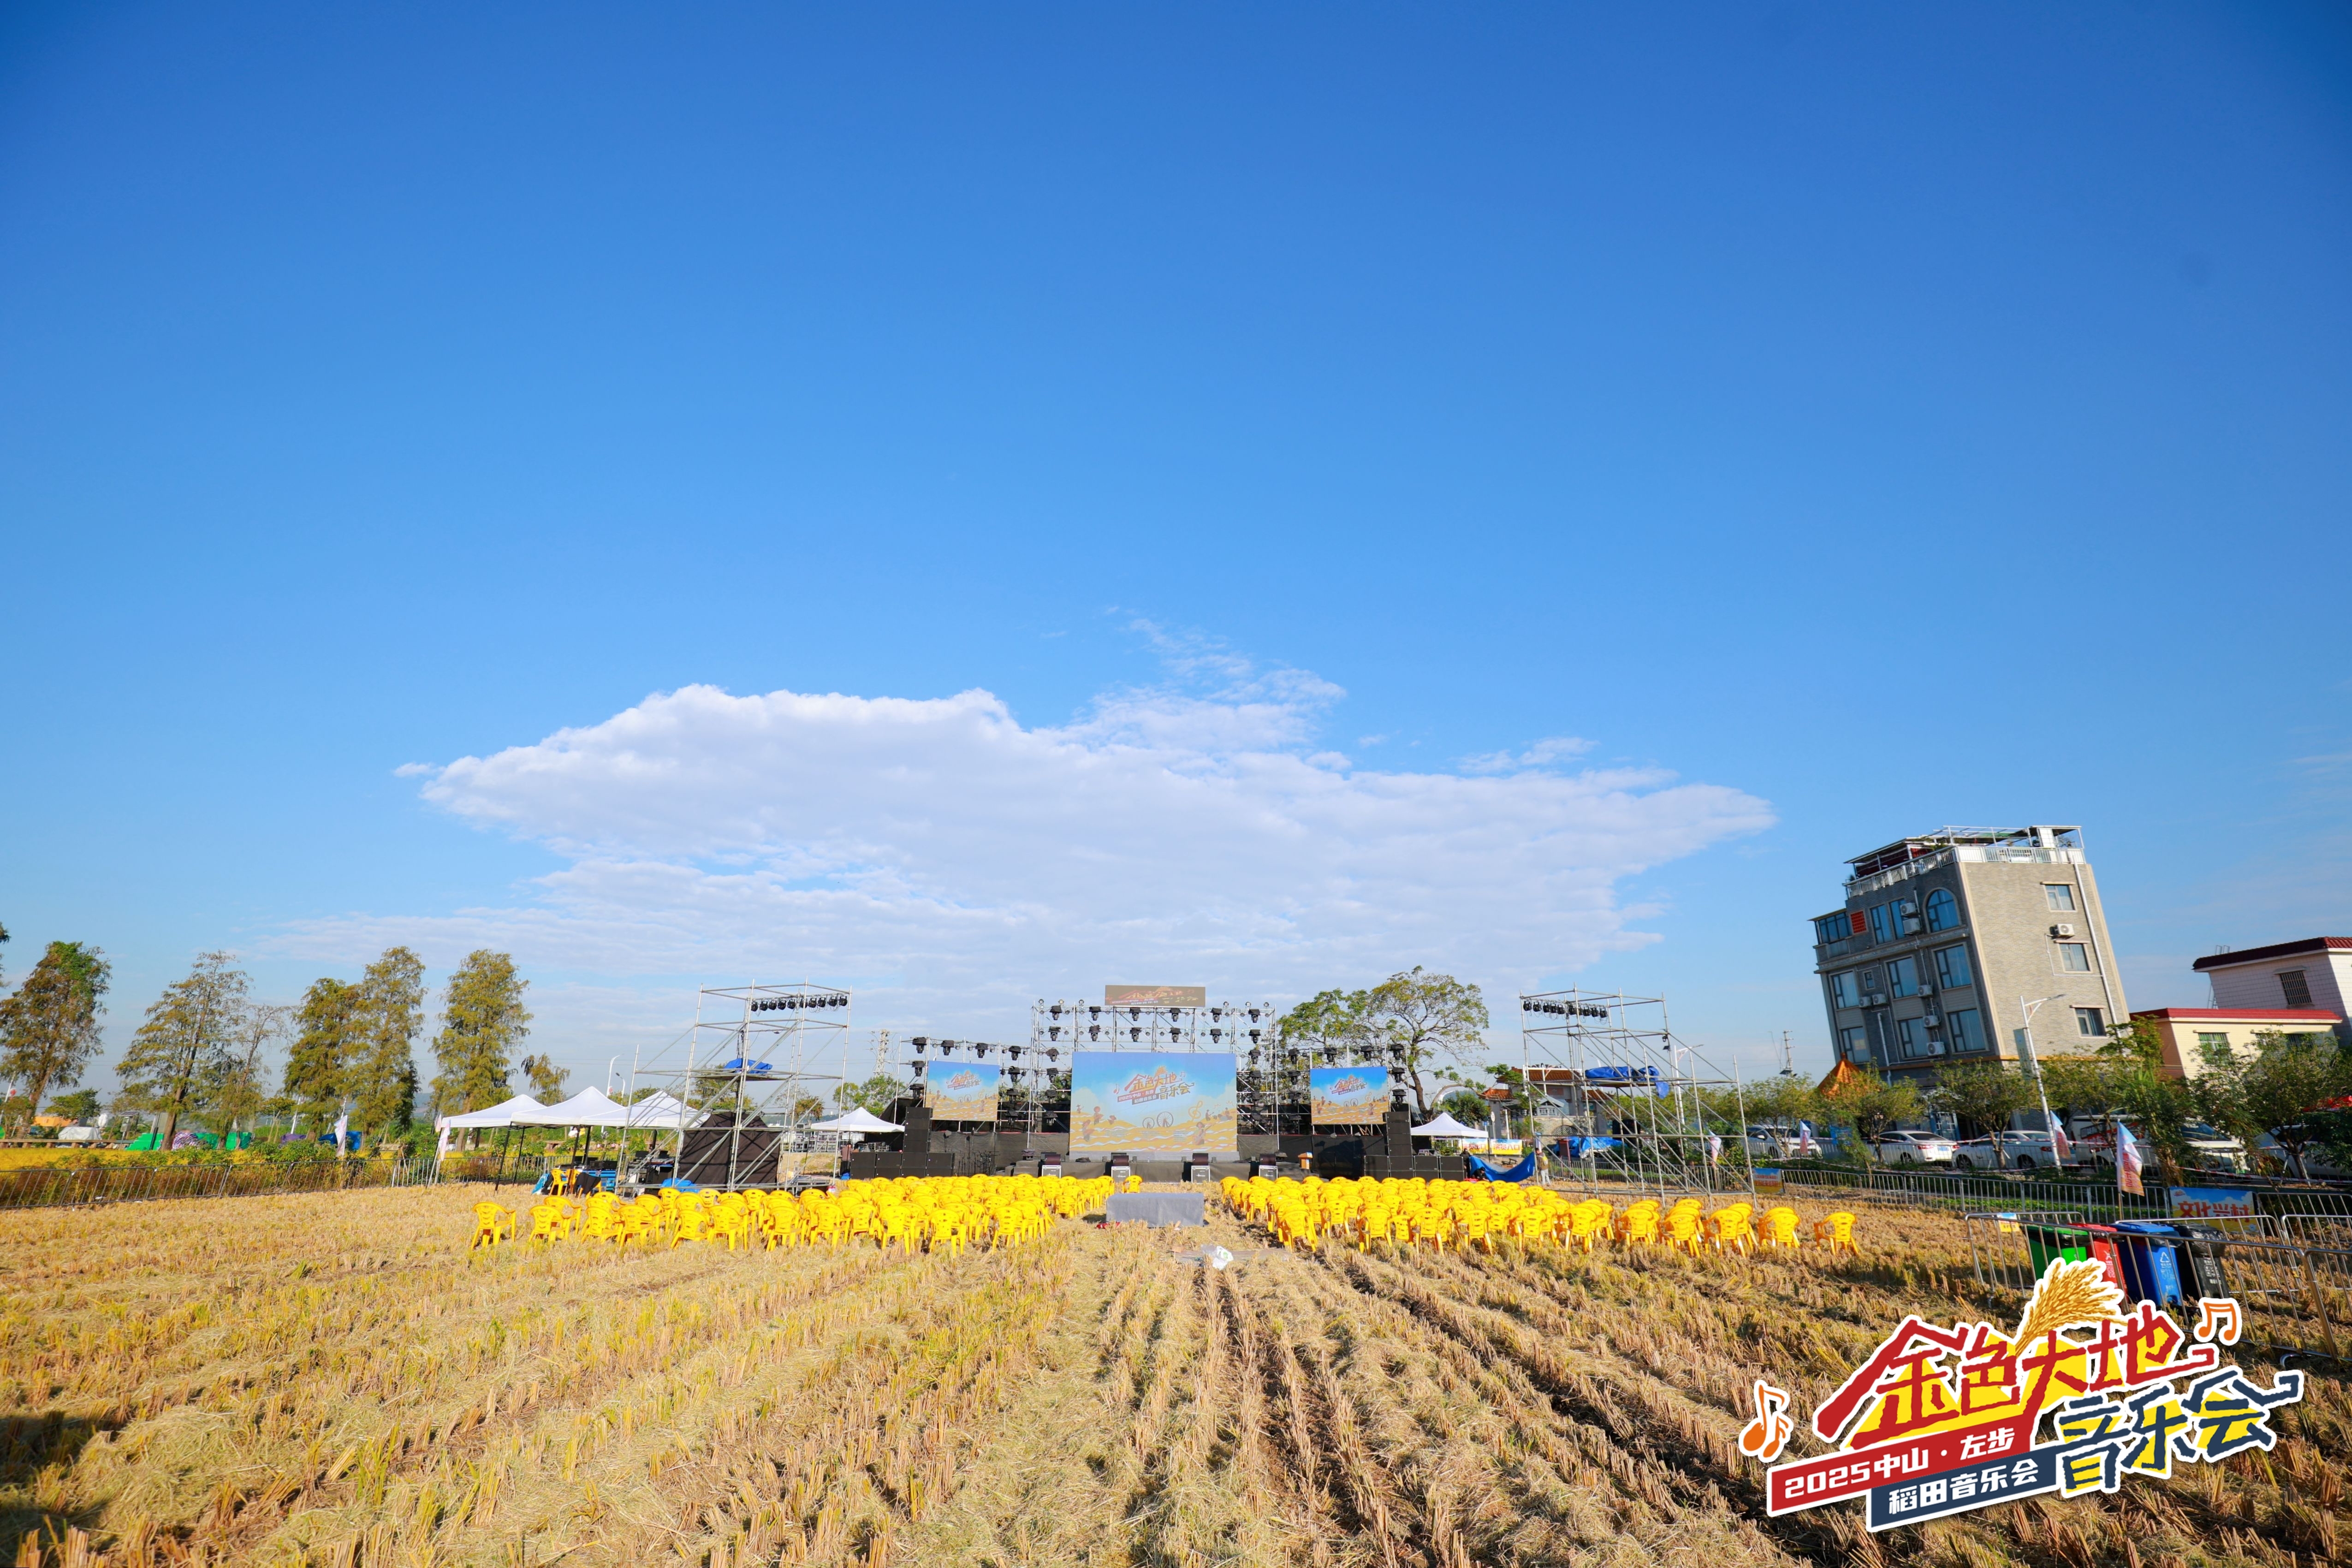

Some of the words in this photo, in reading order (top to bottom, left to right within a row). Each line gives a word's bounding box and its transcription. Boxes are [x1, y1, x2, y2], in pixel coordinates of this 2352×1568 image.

[1159, 1082, 1194, 1099] 音乐会
[2178, 1200, 2250, 1223] 文化兴村
